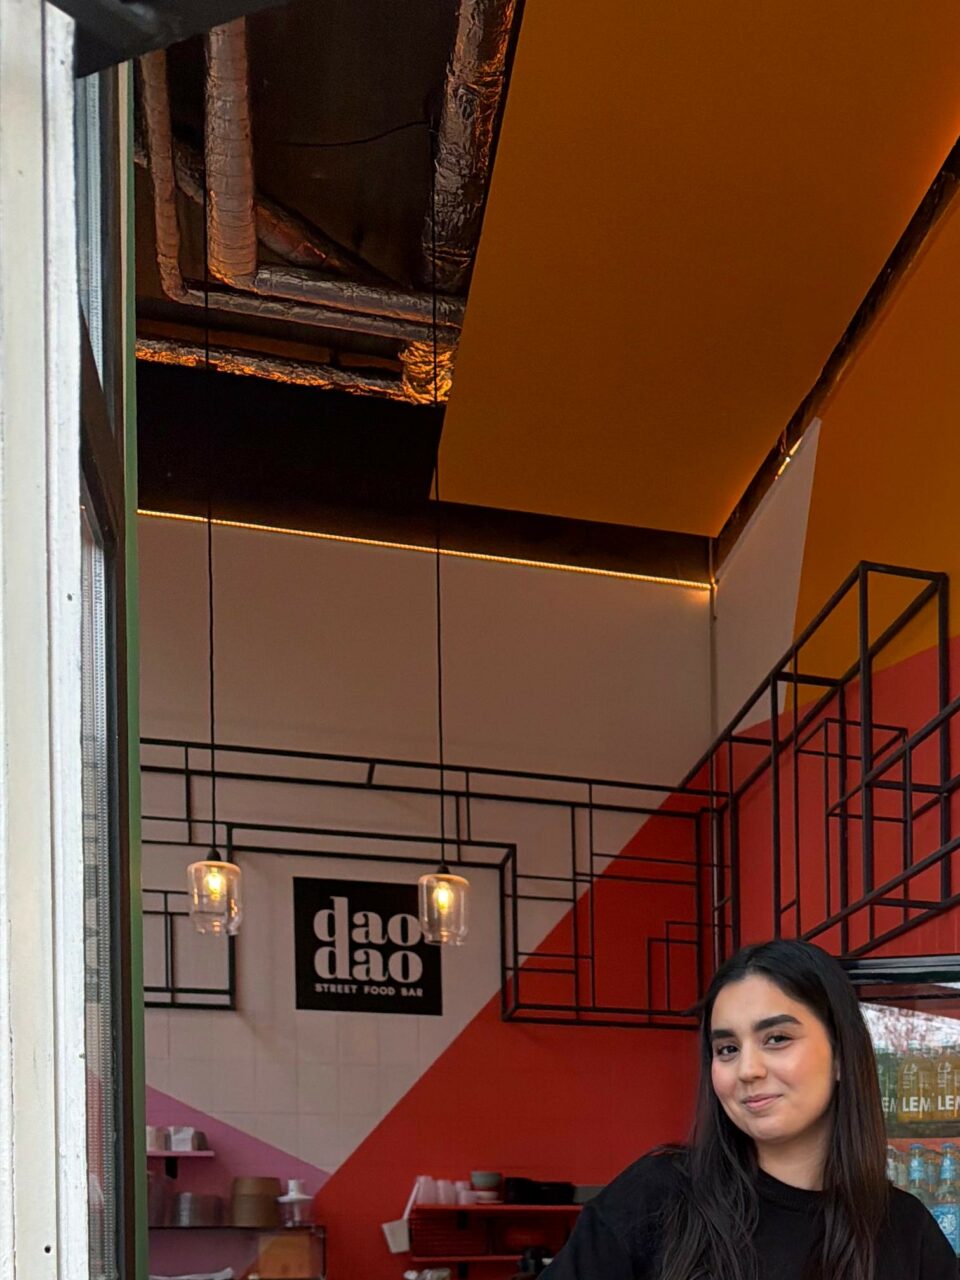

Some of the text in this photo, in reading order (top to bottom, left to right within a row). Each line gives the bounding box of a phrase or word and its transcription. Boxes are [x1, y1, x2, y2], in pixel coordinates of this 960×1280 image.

[313, 895, 422, 947] dao
[313, 945, 423, 984] dao
[314, 983, 424, 998] STREET FOOD BAR
